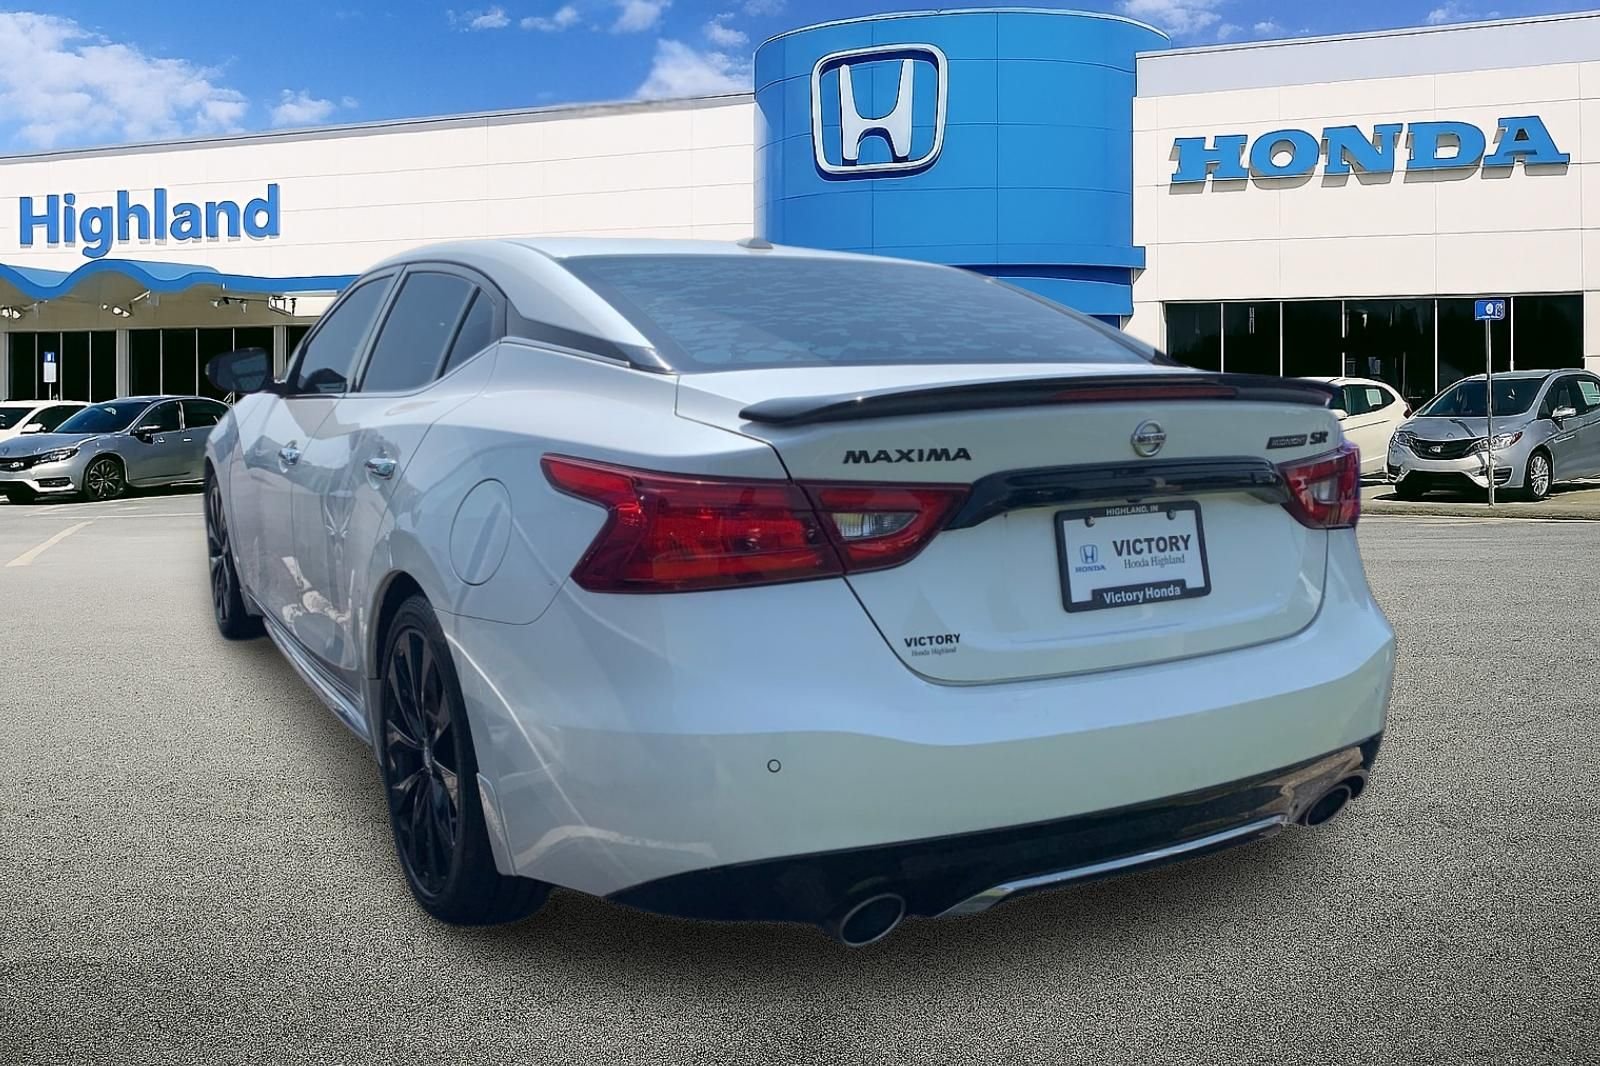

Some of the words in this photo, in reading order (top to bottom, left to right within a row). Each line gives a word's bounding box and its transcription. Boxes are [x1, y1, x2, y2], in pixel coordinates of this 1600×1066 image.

[1171, 115, 1571, 183] HONDA
[19, 183, 280, 258] Highland
[1309, 430, 1329, 445] SR
[843, 447, 972, 464] MAXIMA
[1150, 504, 1159, 512] IN
[1112, 534, 1192, 557] VICTORY
[1075, 565, 1106, 573] HONDA
[1124, 558, 1150, 569] Honda
[1151, 554, 1185, 569] Highland
[1103, 589, 1144, 605] Victory
[1144, 584, 1181, 600] Honda
[904, 633, 961, 648] VICTORY
